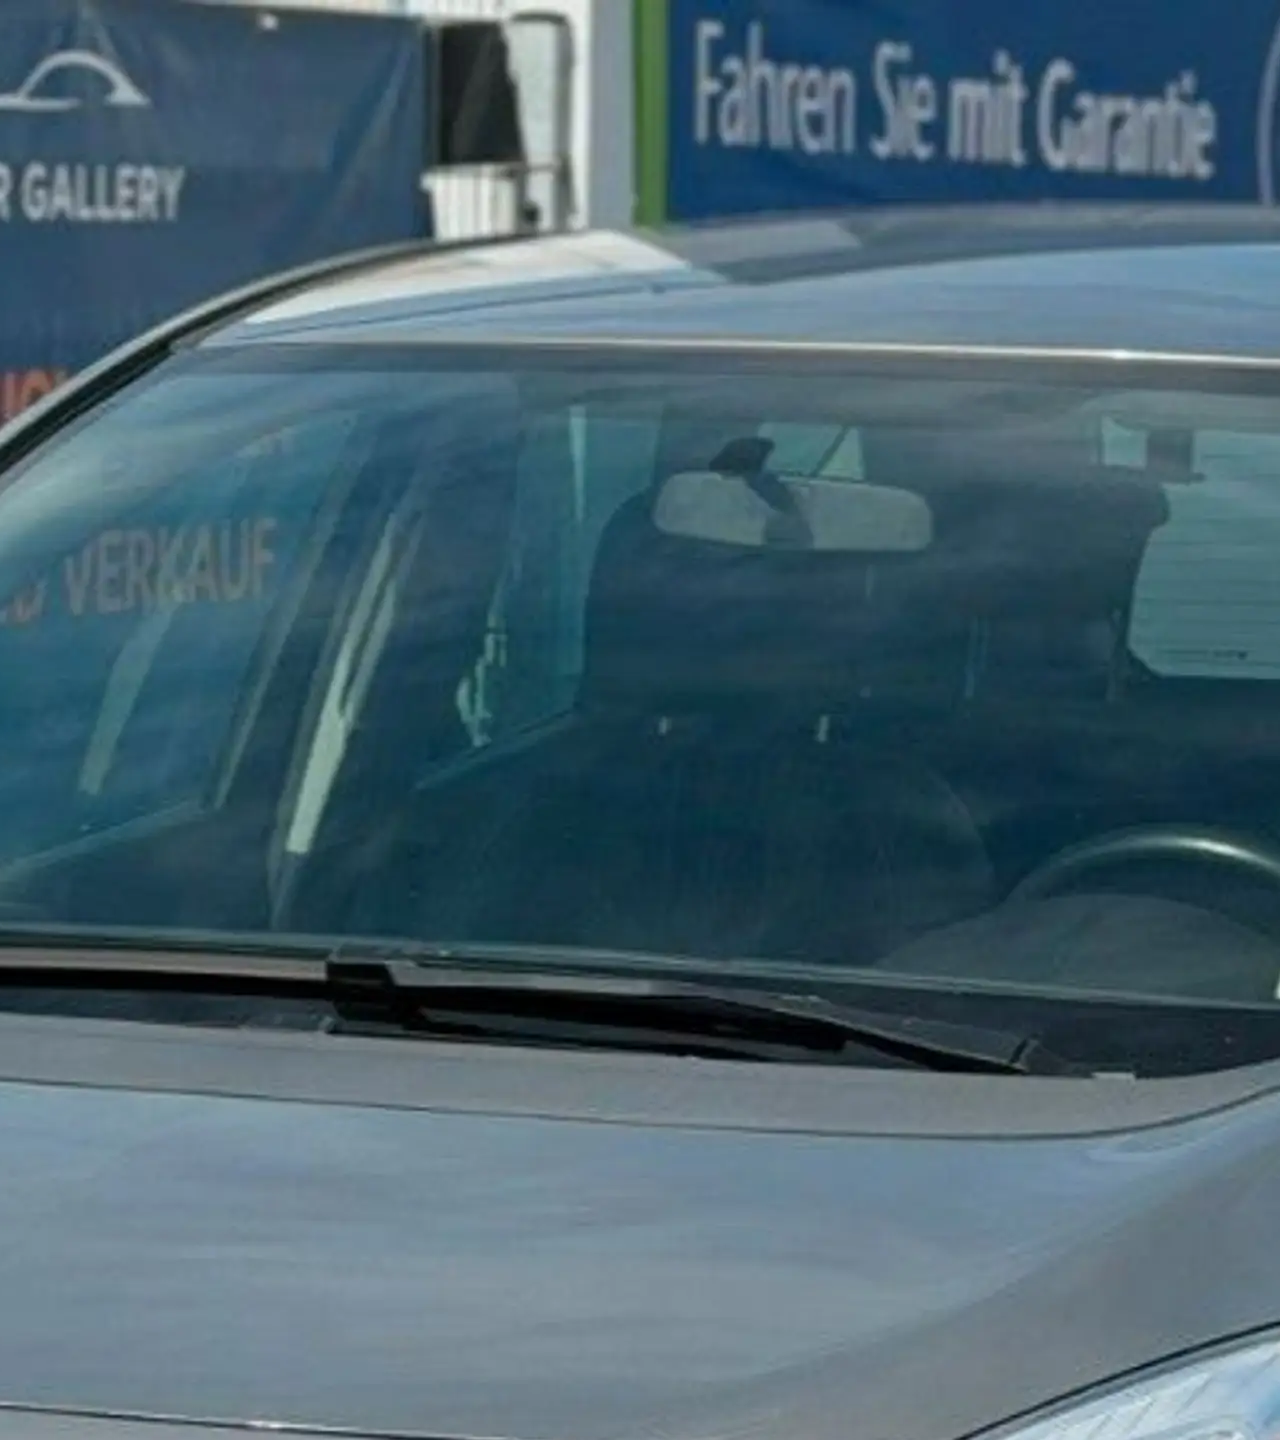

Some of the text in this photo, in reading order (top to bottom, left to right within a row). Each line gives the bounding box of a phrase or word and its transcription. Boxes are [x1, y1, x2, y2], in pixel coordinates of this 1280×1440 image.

[695, 18, 1217, 181] Fahren Sie mit Garantie
[19, 159, 186, 223] GALLERY
[64, 517, 277, 618] VERKAUF
